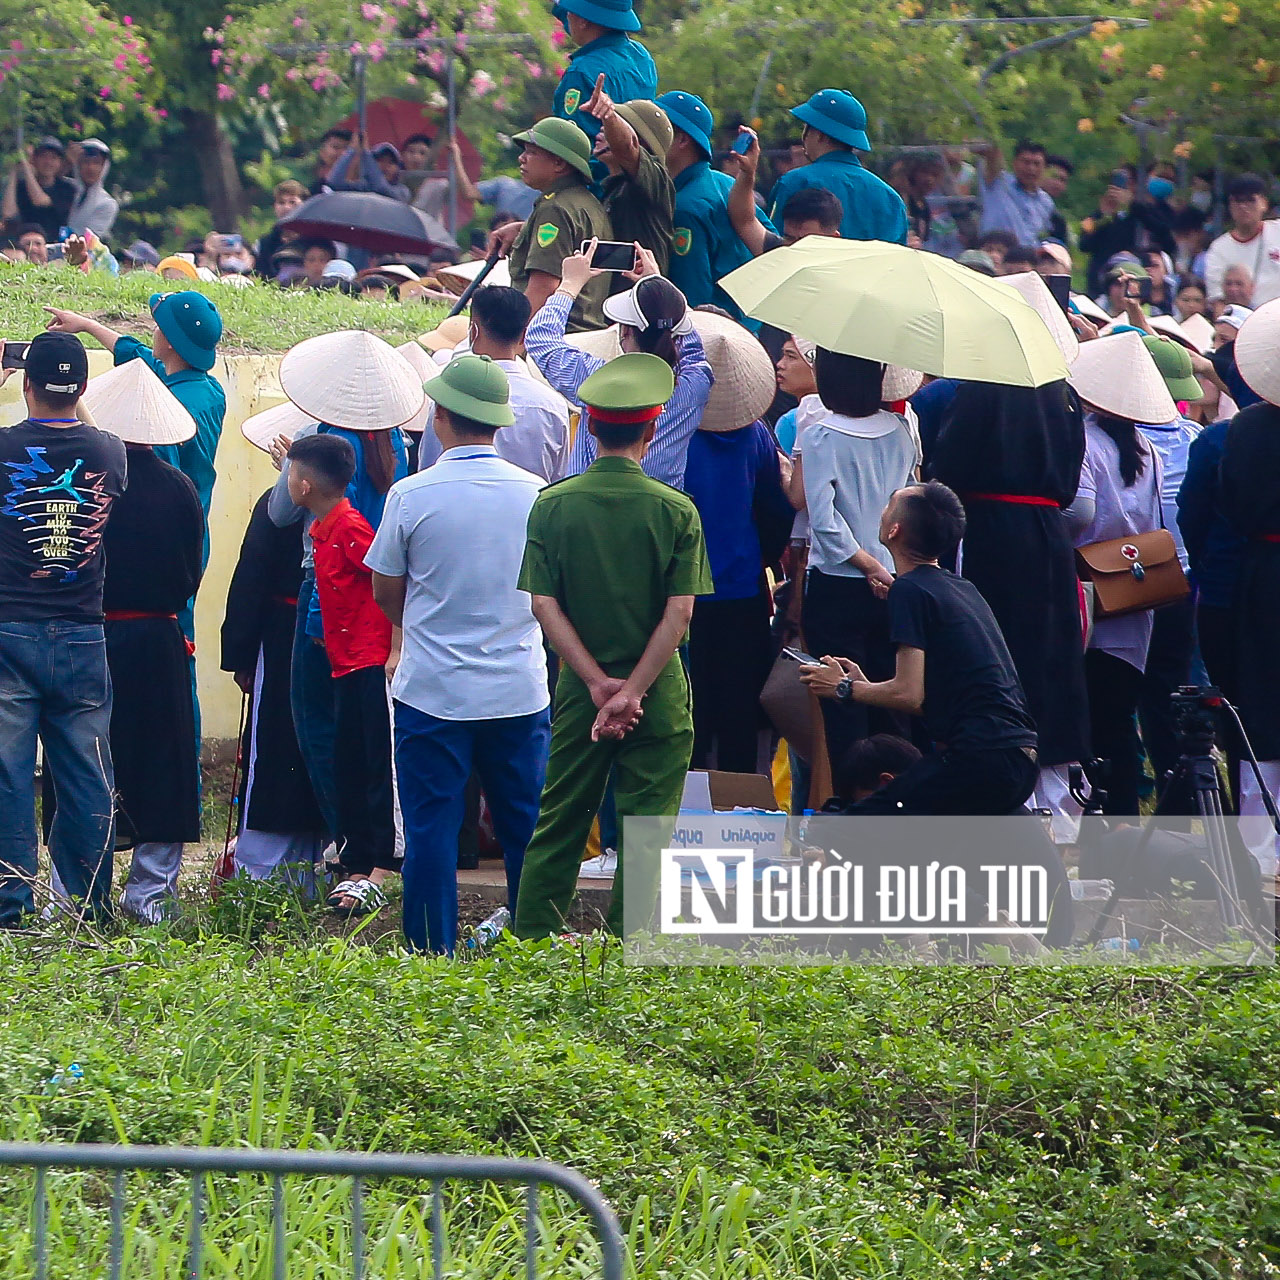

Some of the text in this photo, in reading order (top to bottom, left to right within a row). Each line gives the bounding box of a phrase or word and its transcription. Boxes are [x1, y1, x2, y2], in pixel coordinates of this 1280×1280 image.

[46, 503, 78, 513] EARTH
[49, 535, 69, 544] YOU
[721, 828, 776, 845] UniAqua
